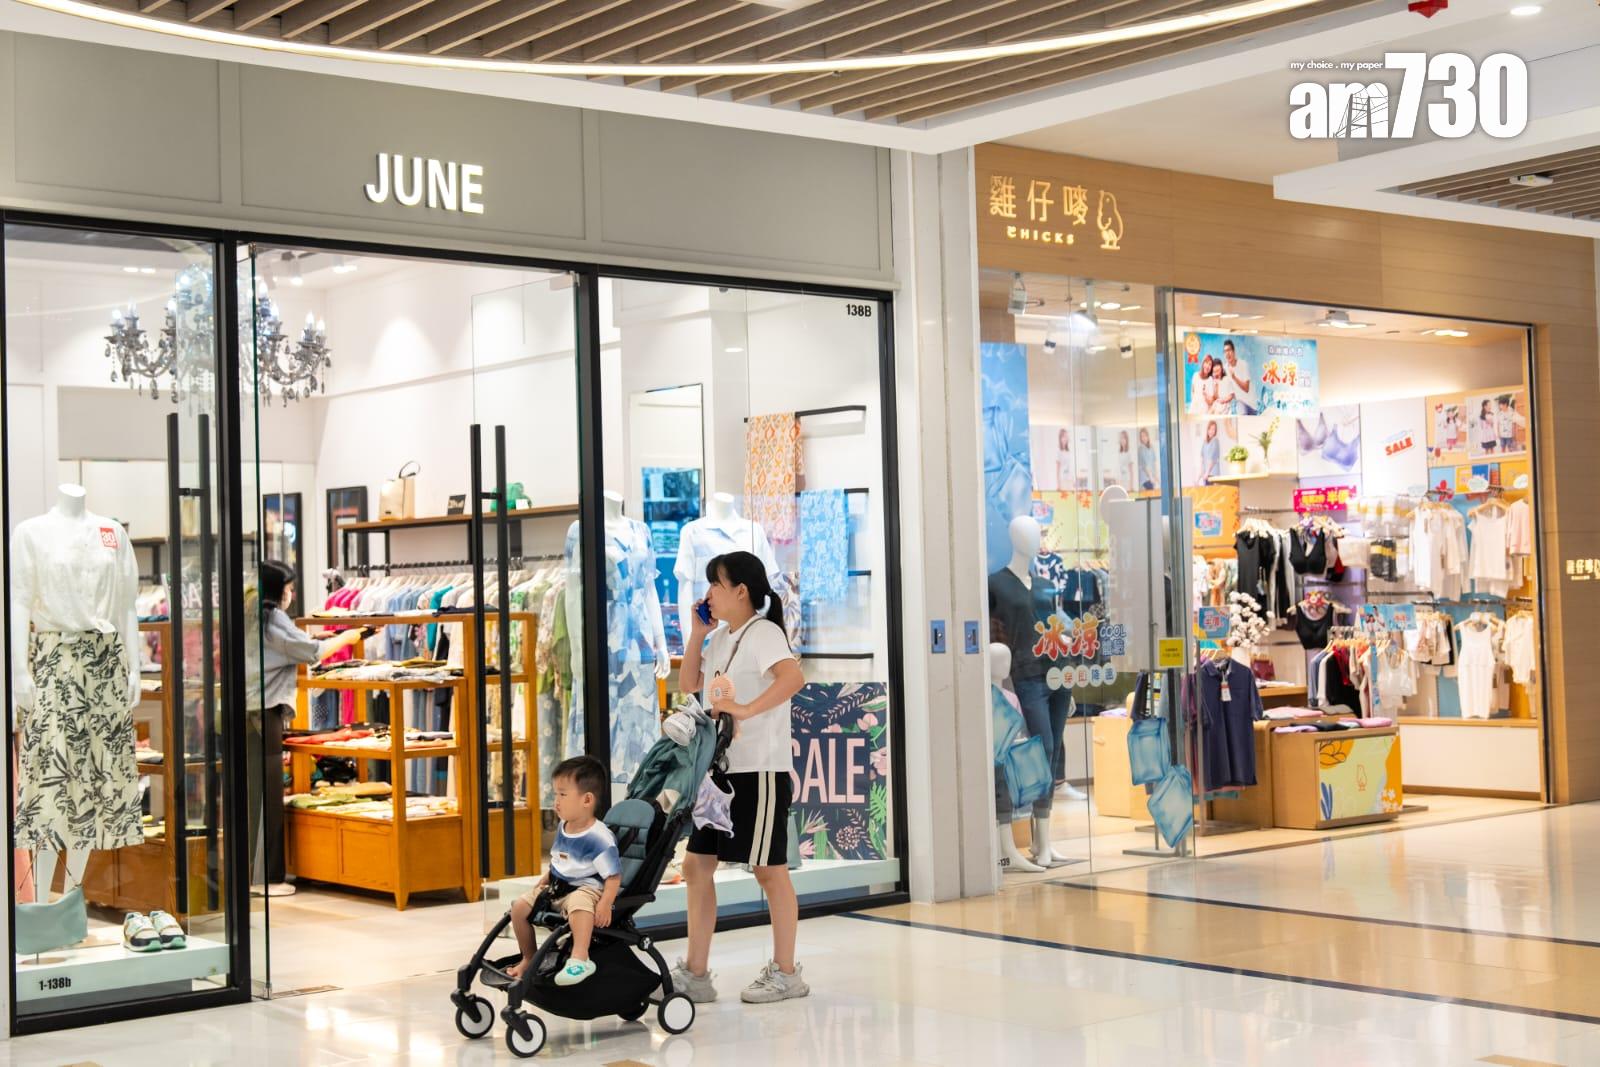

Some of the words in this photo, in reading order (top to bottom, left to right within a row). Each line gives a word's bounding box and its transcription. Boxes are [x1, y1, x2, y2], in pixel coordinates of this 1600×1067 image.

[363, 152, 484, 214] JUNE
[989, 174, 1089, 226] 雞仔嘜
[1007, 225, 1075, 245] CHICKS
[846, 303, 872, 317] 138B
[1385, 436, 1413, 456] SALE
[1033, 613, 1100, 660] 冰涼
[1100, 623, 1127, 637] COOL
